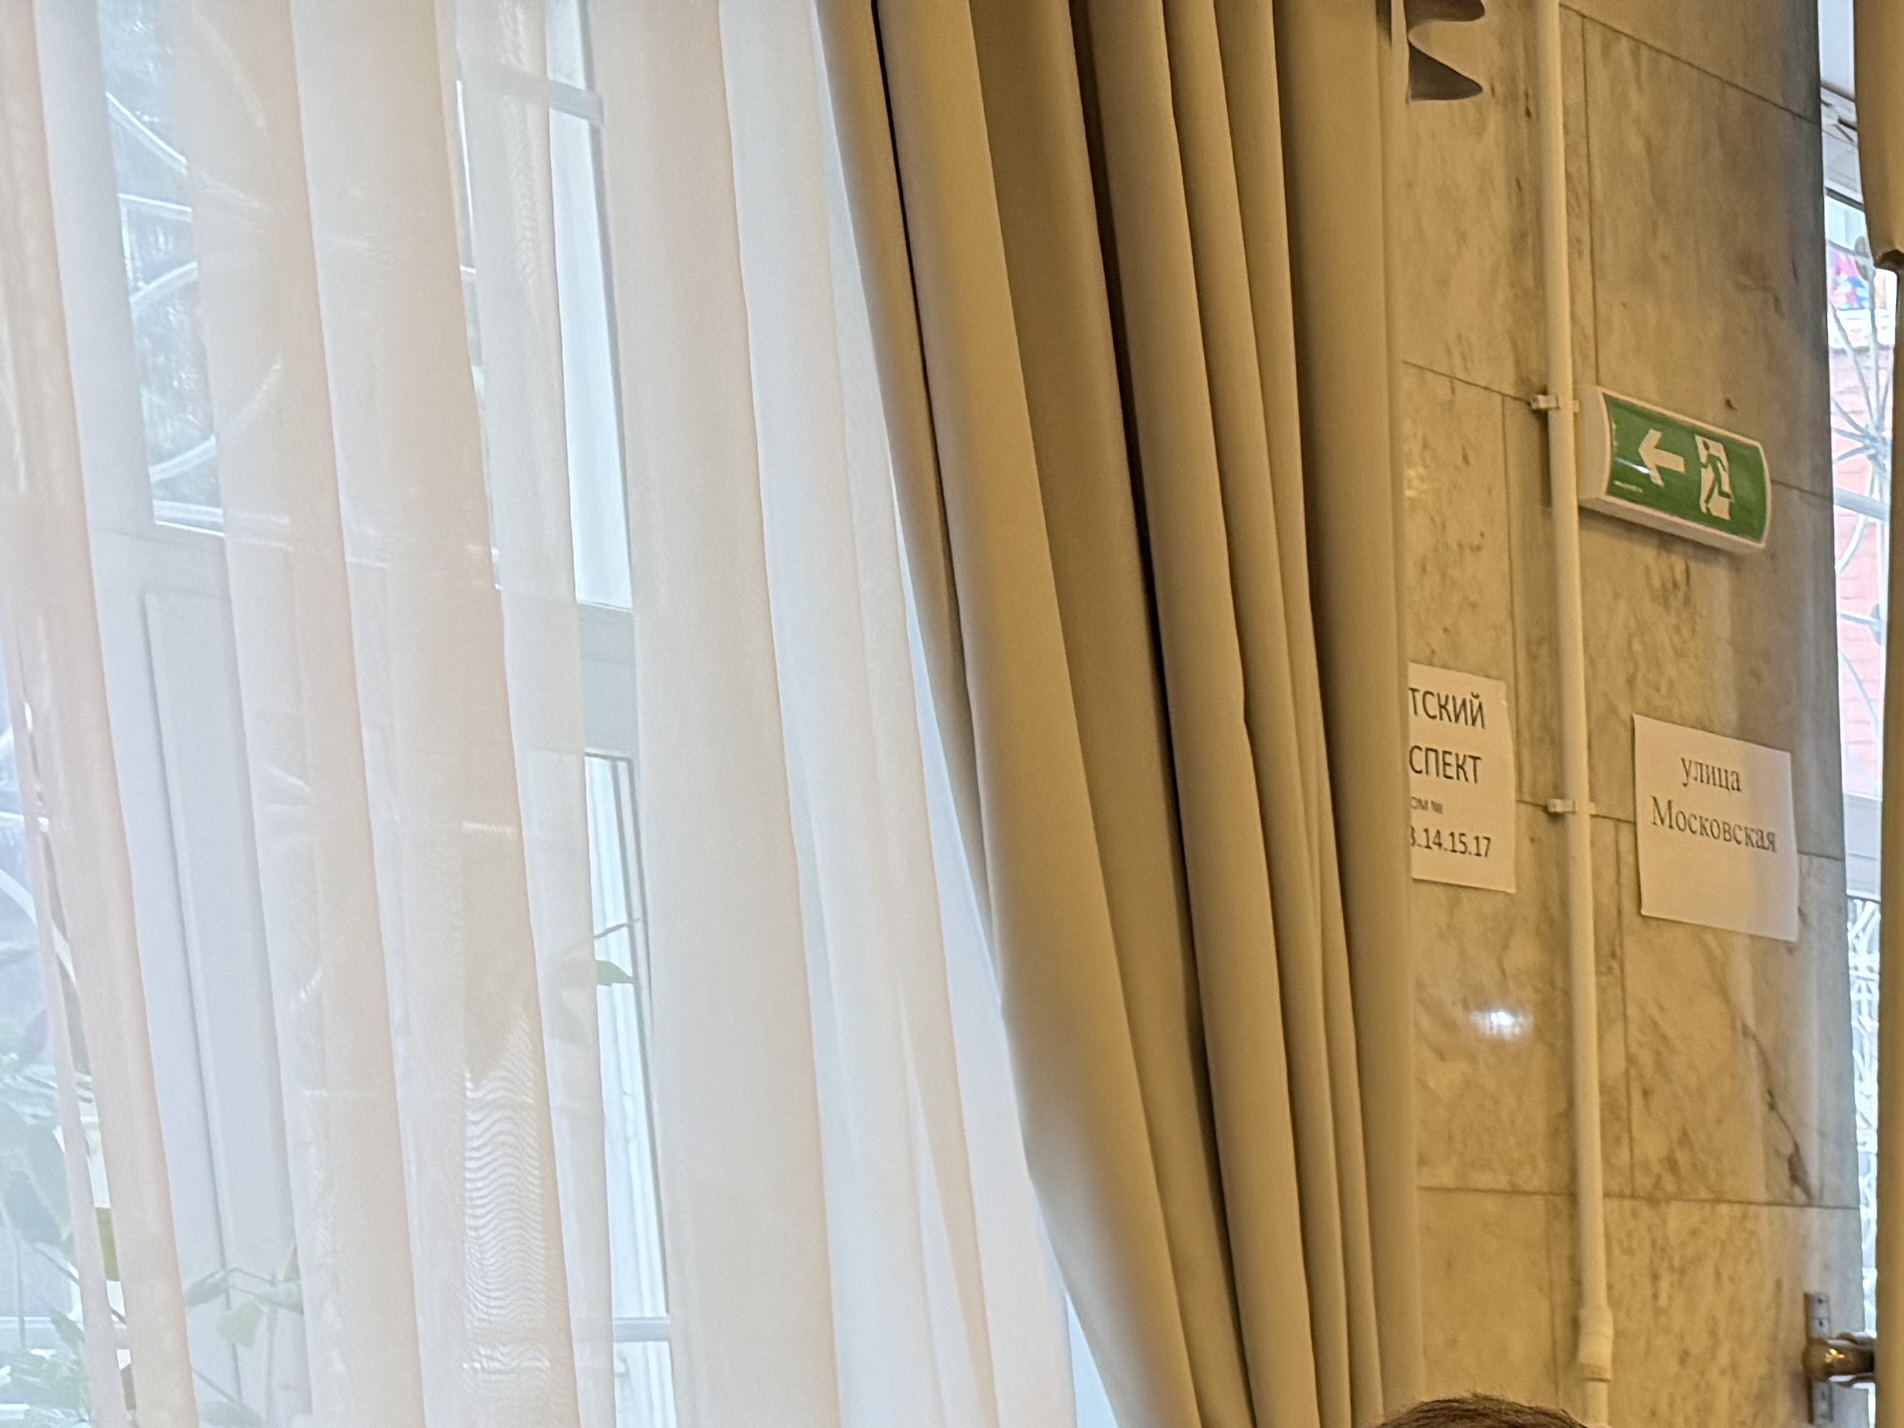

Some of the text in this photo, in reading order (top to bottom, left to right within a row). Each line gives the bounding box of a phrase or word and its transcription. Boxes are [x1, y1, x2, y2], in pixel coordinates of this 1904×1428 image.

[1407, 687, 1486, 730] ТСКИЙ
[1408, 744, 1482, 785] СПЕКТ
[1680, 757, 1742, 793] улица
[1409, 826, 1492, 858] 3.14.15.17
[1649, 795, 1777, 853] Московская
